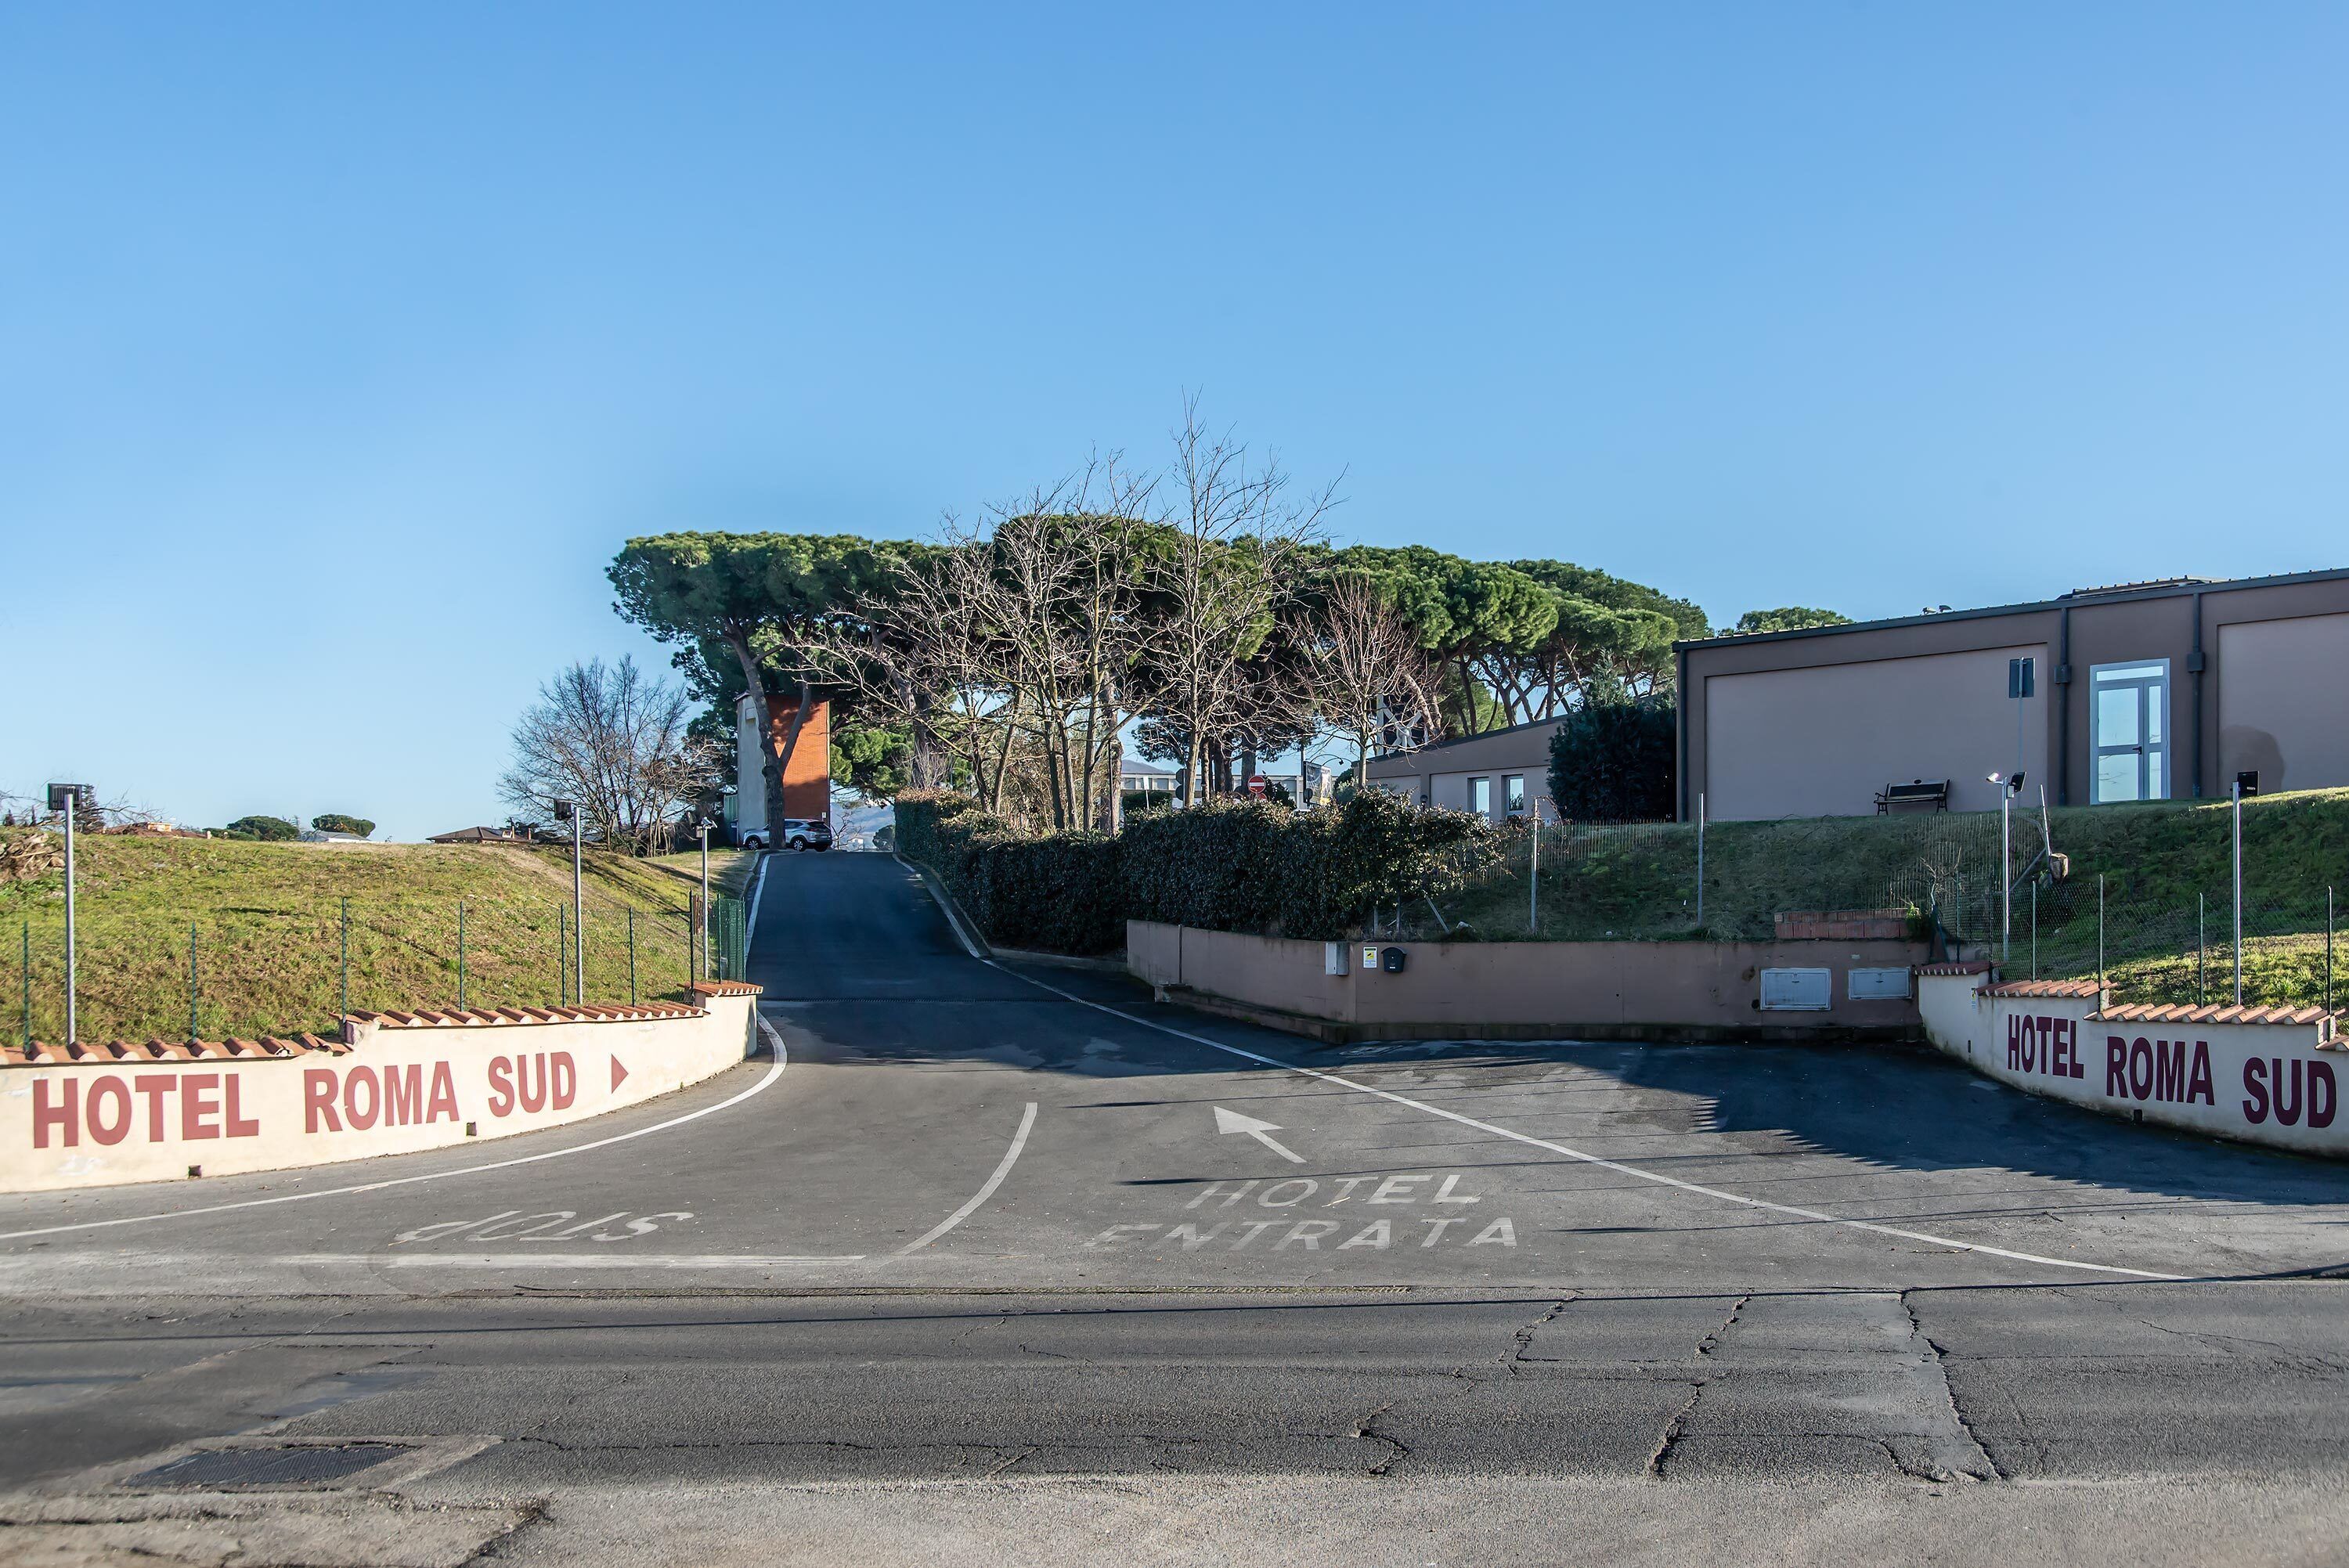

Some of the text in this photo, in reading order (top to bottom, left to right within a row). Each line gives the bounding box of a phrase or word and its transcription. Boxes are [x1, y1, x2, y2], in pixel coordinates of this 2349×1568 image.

[2008, 1014, 2337, 1128] HOTEL ROMA SUD
[33, 1051, 577, 1148] HOTEL ROMA SUD
[1185, 1174, 1481, 1209] HOTEL
[391, 1210, 695, 1242] STOP
[1082, 1217, 1518, 1251] ENTRATA
